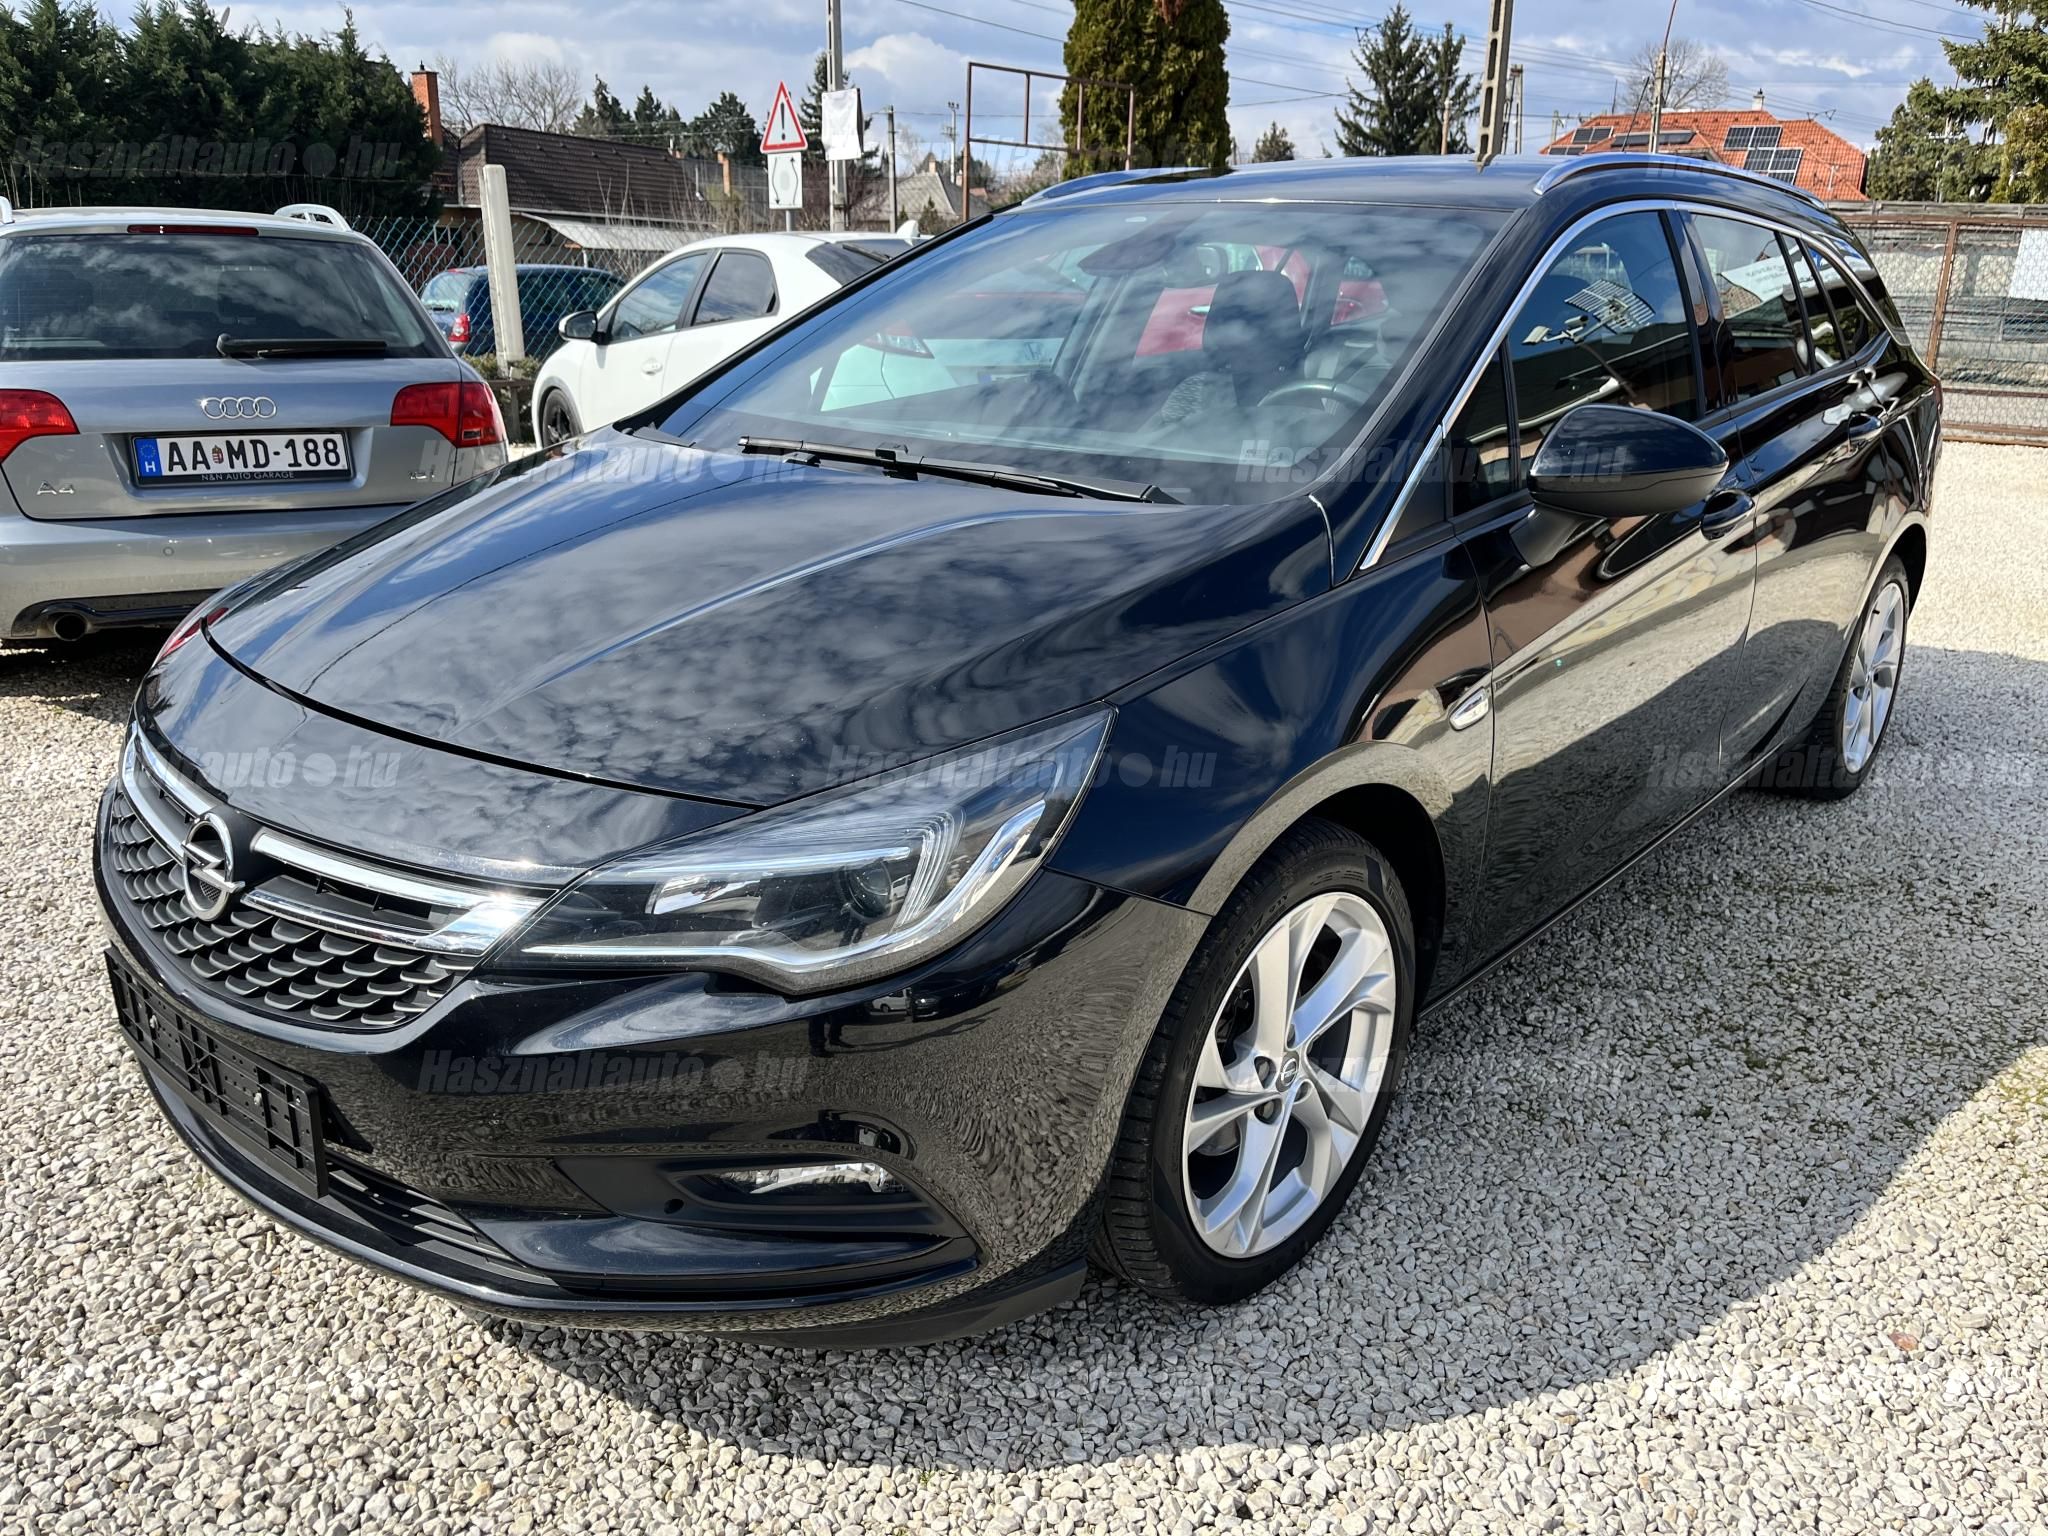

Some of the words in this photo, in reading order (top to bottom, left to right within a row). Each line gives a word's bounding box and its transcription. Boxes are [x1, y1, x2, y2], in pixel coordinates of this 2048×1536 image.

[168, 441, 211, 472] AA
[225, 438, 341, 469] MD-188
[145, 461, 156, 473] H
[226, 472, 252, 480] AUTO
[253, 470, 295, 479] GARAGE
[36, 480, 75, 495] A4
